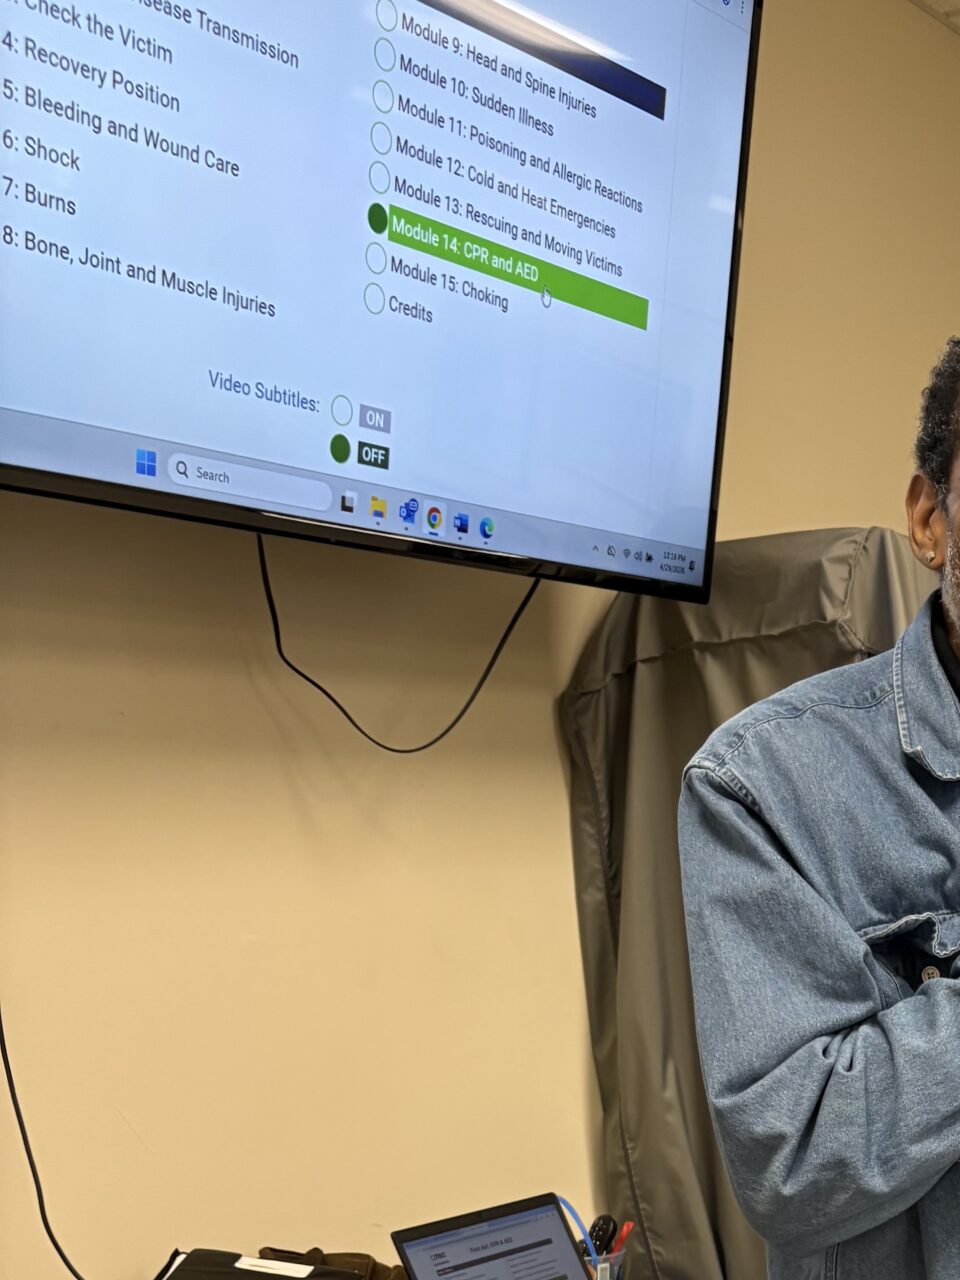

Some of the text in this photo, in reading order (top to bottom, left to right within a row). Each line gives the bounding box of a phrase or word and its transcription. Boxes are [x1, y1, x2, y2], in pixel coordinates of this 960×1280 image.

[86, 14, 114, 40] the
[119, 25, 173, 64] Victim
[196, 9, 299, 69] Transmission
[402, 13, 597, 119] Module 9: Head and Spine Injuries
[2, 31, 181, 112] 4: Recovery Position
[400, 54, 554, 137] Module 10: Sudden Illness
[2, 79, 240, 176] 5: Bleeding and Wound Care
[2, 129, 81, 171] 6: Shock
[398, 94, 643, 213] Module 11: Poisoning and Allergic Reactions
[2, 176, 76, 216] 7: Burns
[396, 136, 616, 238] Module 12: Cold and Heat Emergencies
[392, 215, 538, 282] Module 14: CPR and AED
[394, 176, 623, 277] Module 13: Rescuing and Moving Victims
[2, 226, 276, 317] 8: Bone, Joint and Muscle Injuries
[390, 256, 509, 312] Module 15: Choking
[388, 296, 433, 323] Credits
[209, 370, 320, 413] Video Subtitles:
[366, 410, 384, 429] ON
[197, 466, 230, 484] Search
[362, 446, 386, 465] OFF
